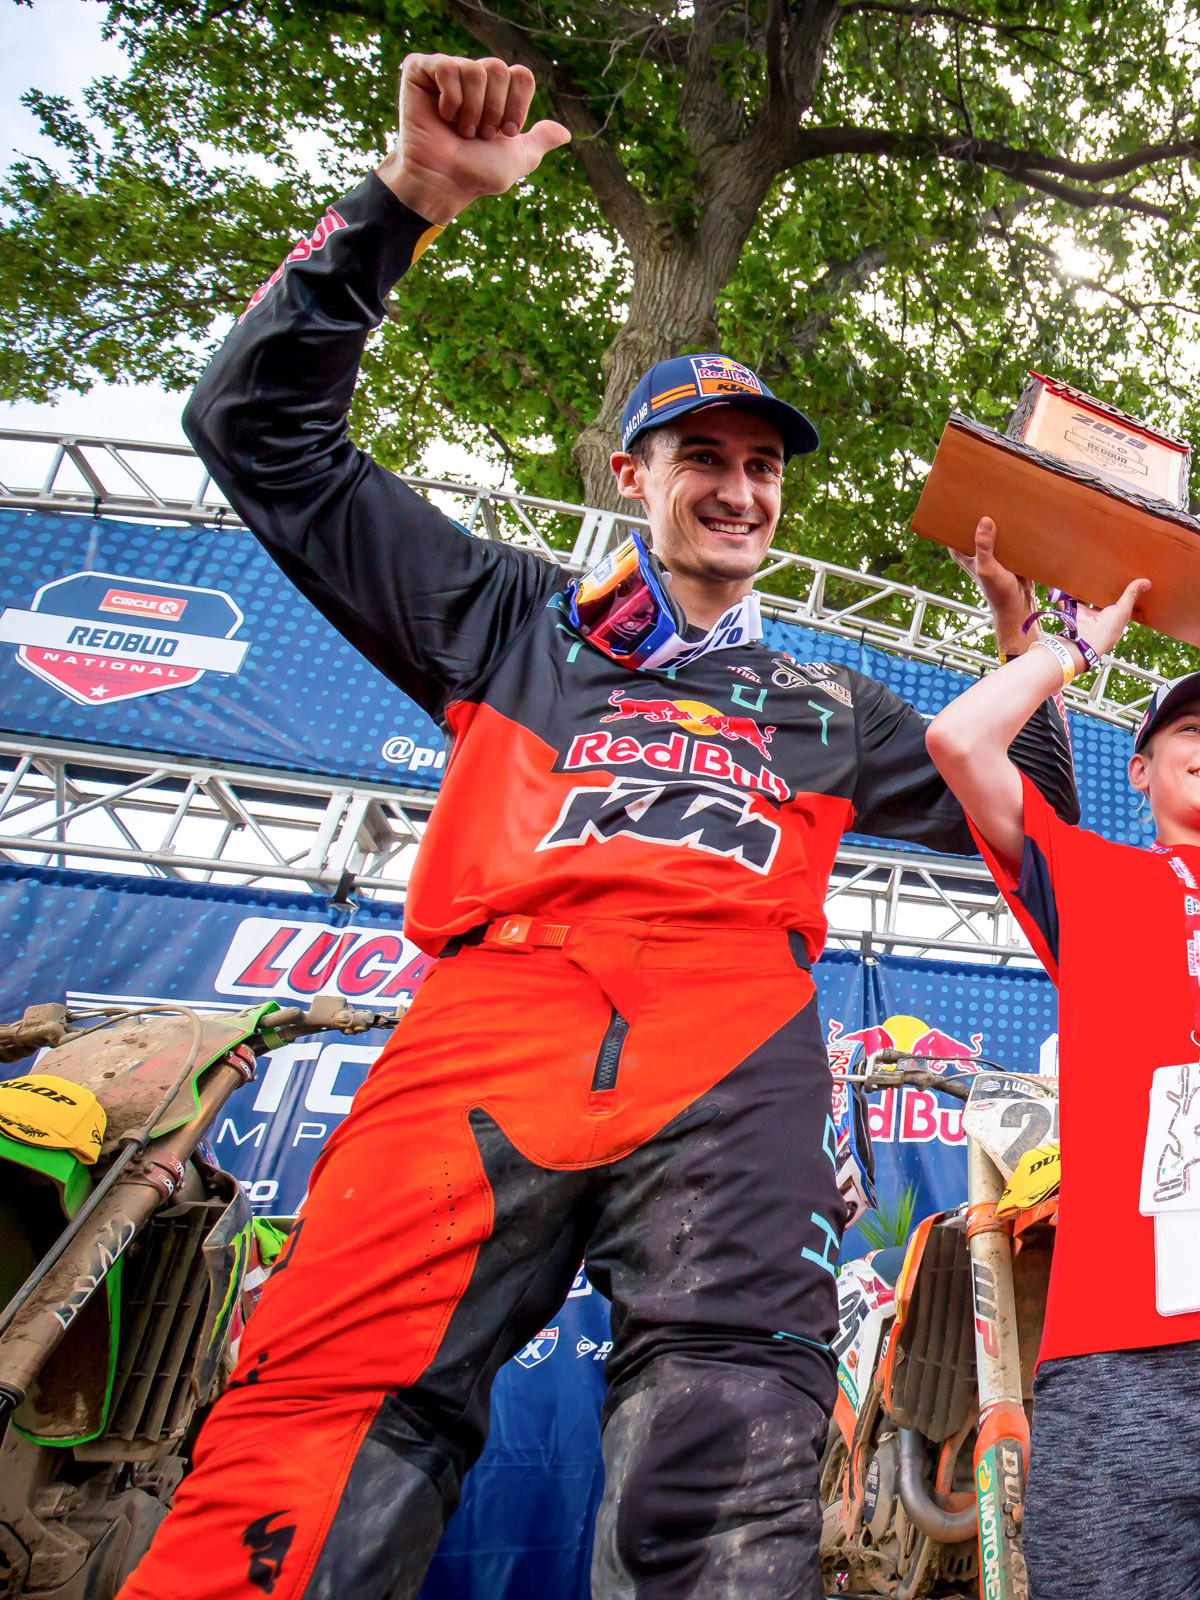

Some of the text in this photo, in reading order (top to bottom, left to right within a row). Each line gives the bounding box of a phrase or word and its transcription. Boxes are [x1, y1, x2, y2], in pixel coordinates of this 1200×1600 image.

[699, 367, 759, 389] Red Bull
[1071, 413, 1148, 450] 2019
[1087, 442, 1128, 464] REDBUD
[111, 596, 159, 612] CIRCLE
[67, 626, 179, 657] REDBUD
[42, 652, 180, 679] NATIONAL
[563, 731, 791, 802] Red Bull
[534, 776, 781, 875] KTM
[1000, 1102, 1059, 1175] 2
